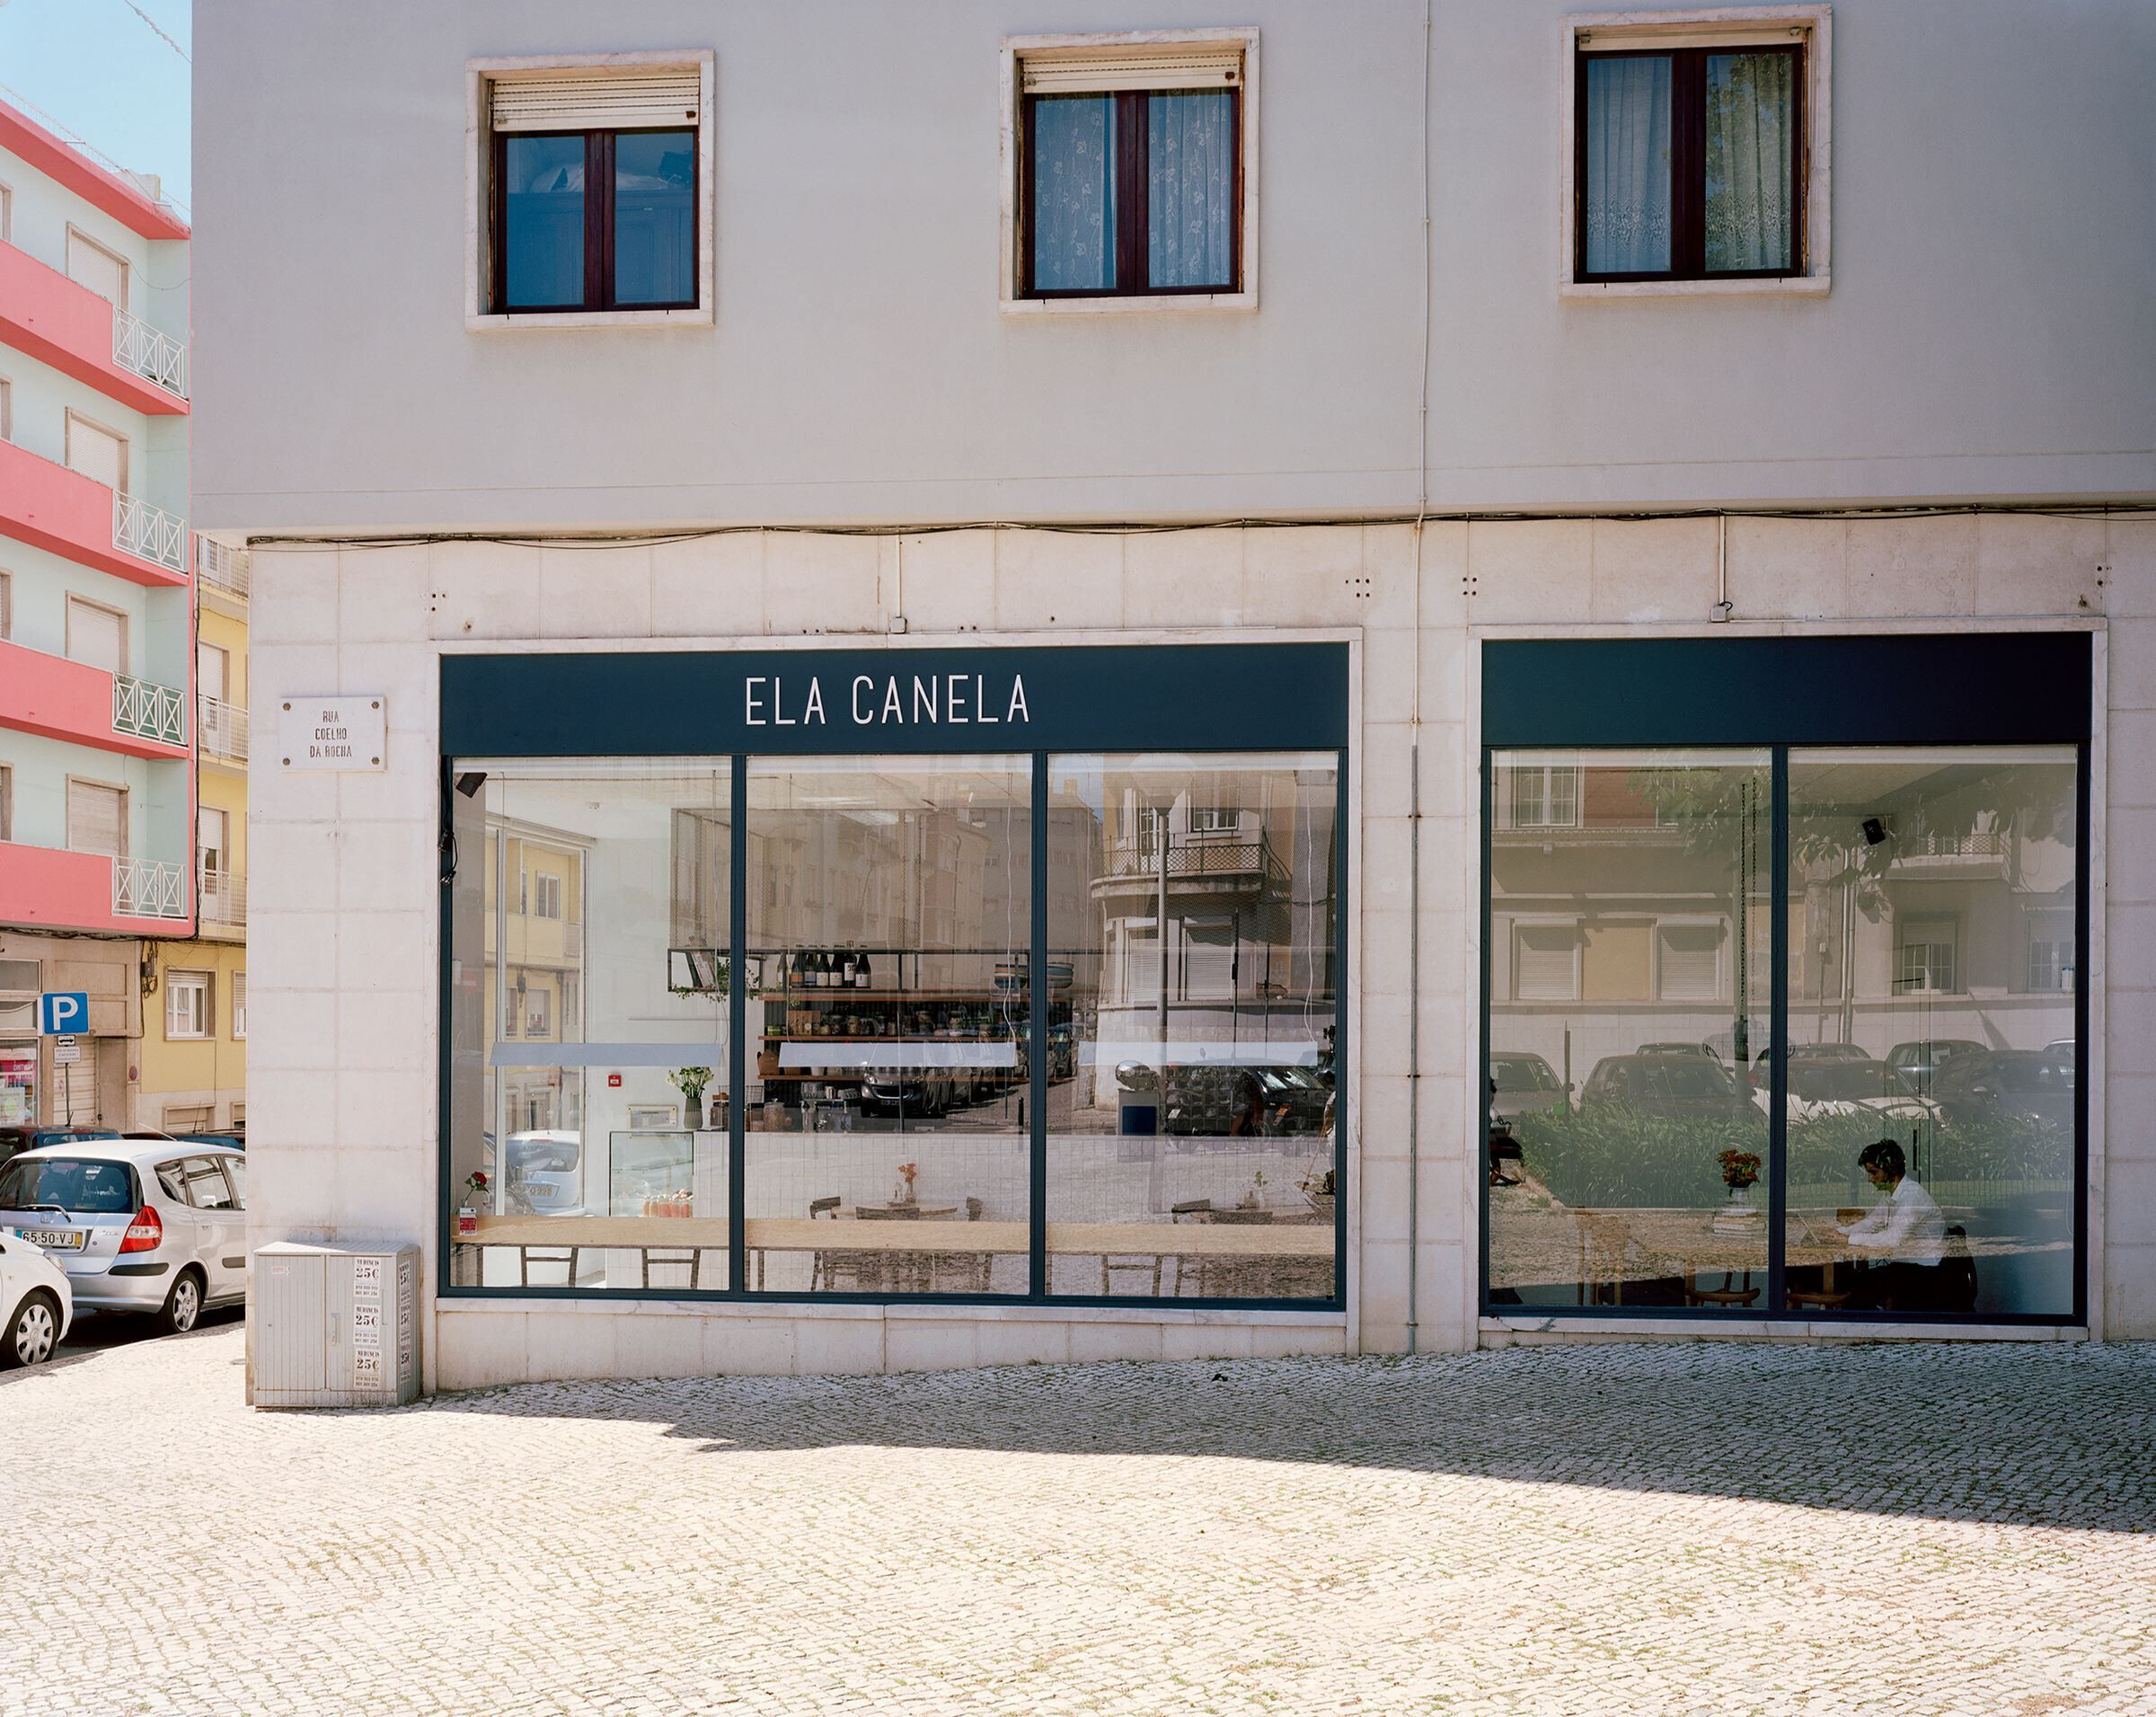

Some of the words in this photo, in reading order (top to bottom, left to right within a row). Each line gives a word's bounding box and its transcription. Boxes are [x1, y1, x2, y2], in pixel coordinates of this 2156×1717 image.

[746, 677, 826, 725] ELA
[853, 674, 1029, 724] CANELA
[323, 711, 340, 722] RUA
[314, 728, 347, 740] COELHO
[309, 746, 322, 757] DA
[325, 746, 352, 757] ROCHA
[52, 996, 79, 1031] P
[356, 1268, 379, 1278] 25€
[356, 1315, 378, 1325] 25€
[357, 1359, 379, 1369] 25€
